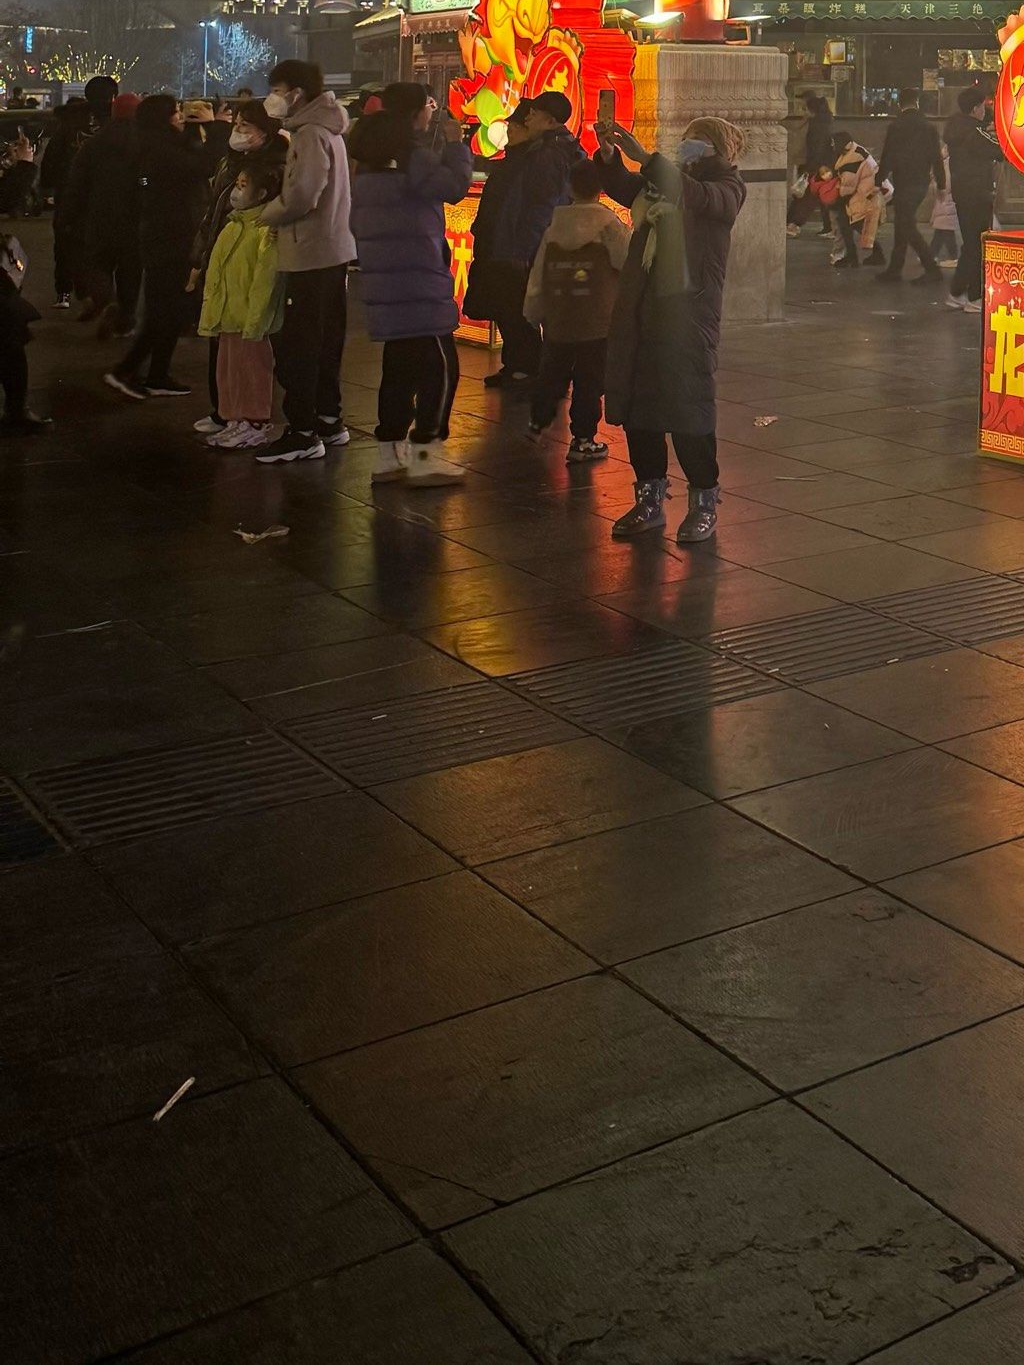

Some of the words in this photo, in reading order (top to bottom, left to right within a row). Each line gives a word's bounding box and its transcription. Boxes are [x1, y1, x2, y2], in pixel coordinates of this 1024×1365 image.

[752, 2, 867, 15] 耳朵眼炸糕
[900, 2, 984, 15] 天津三绝
